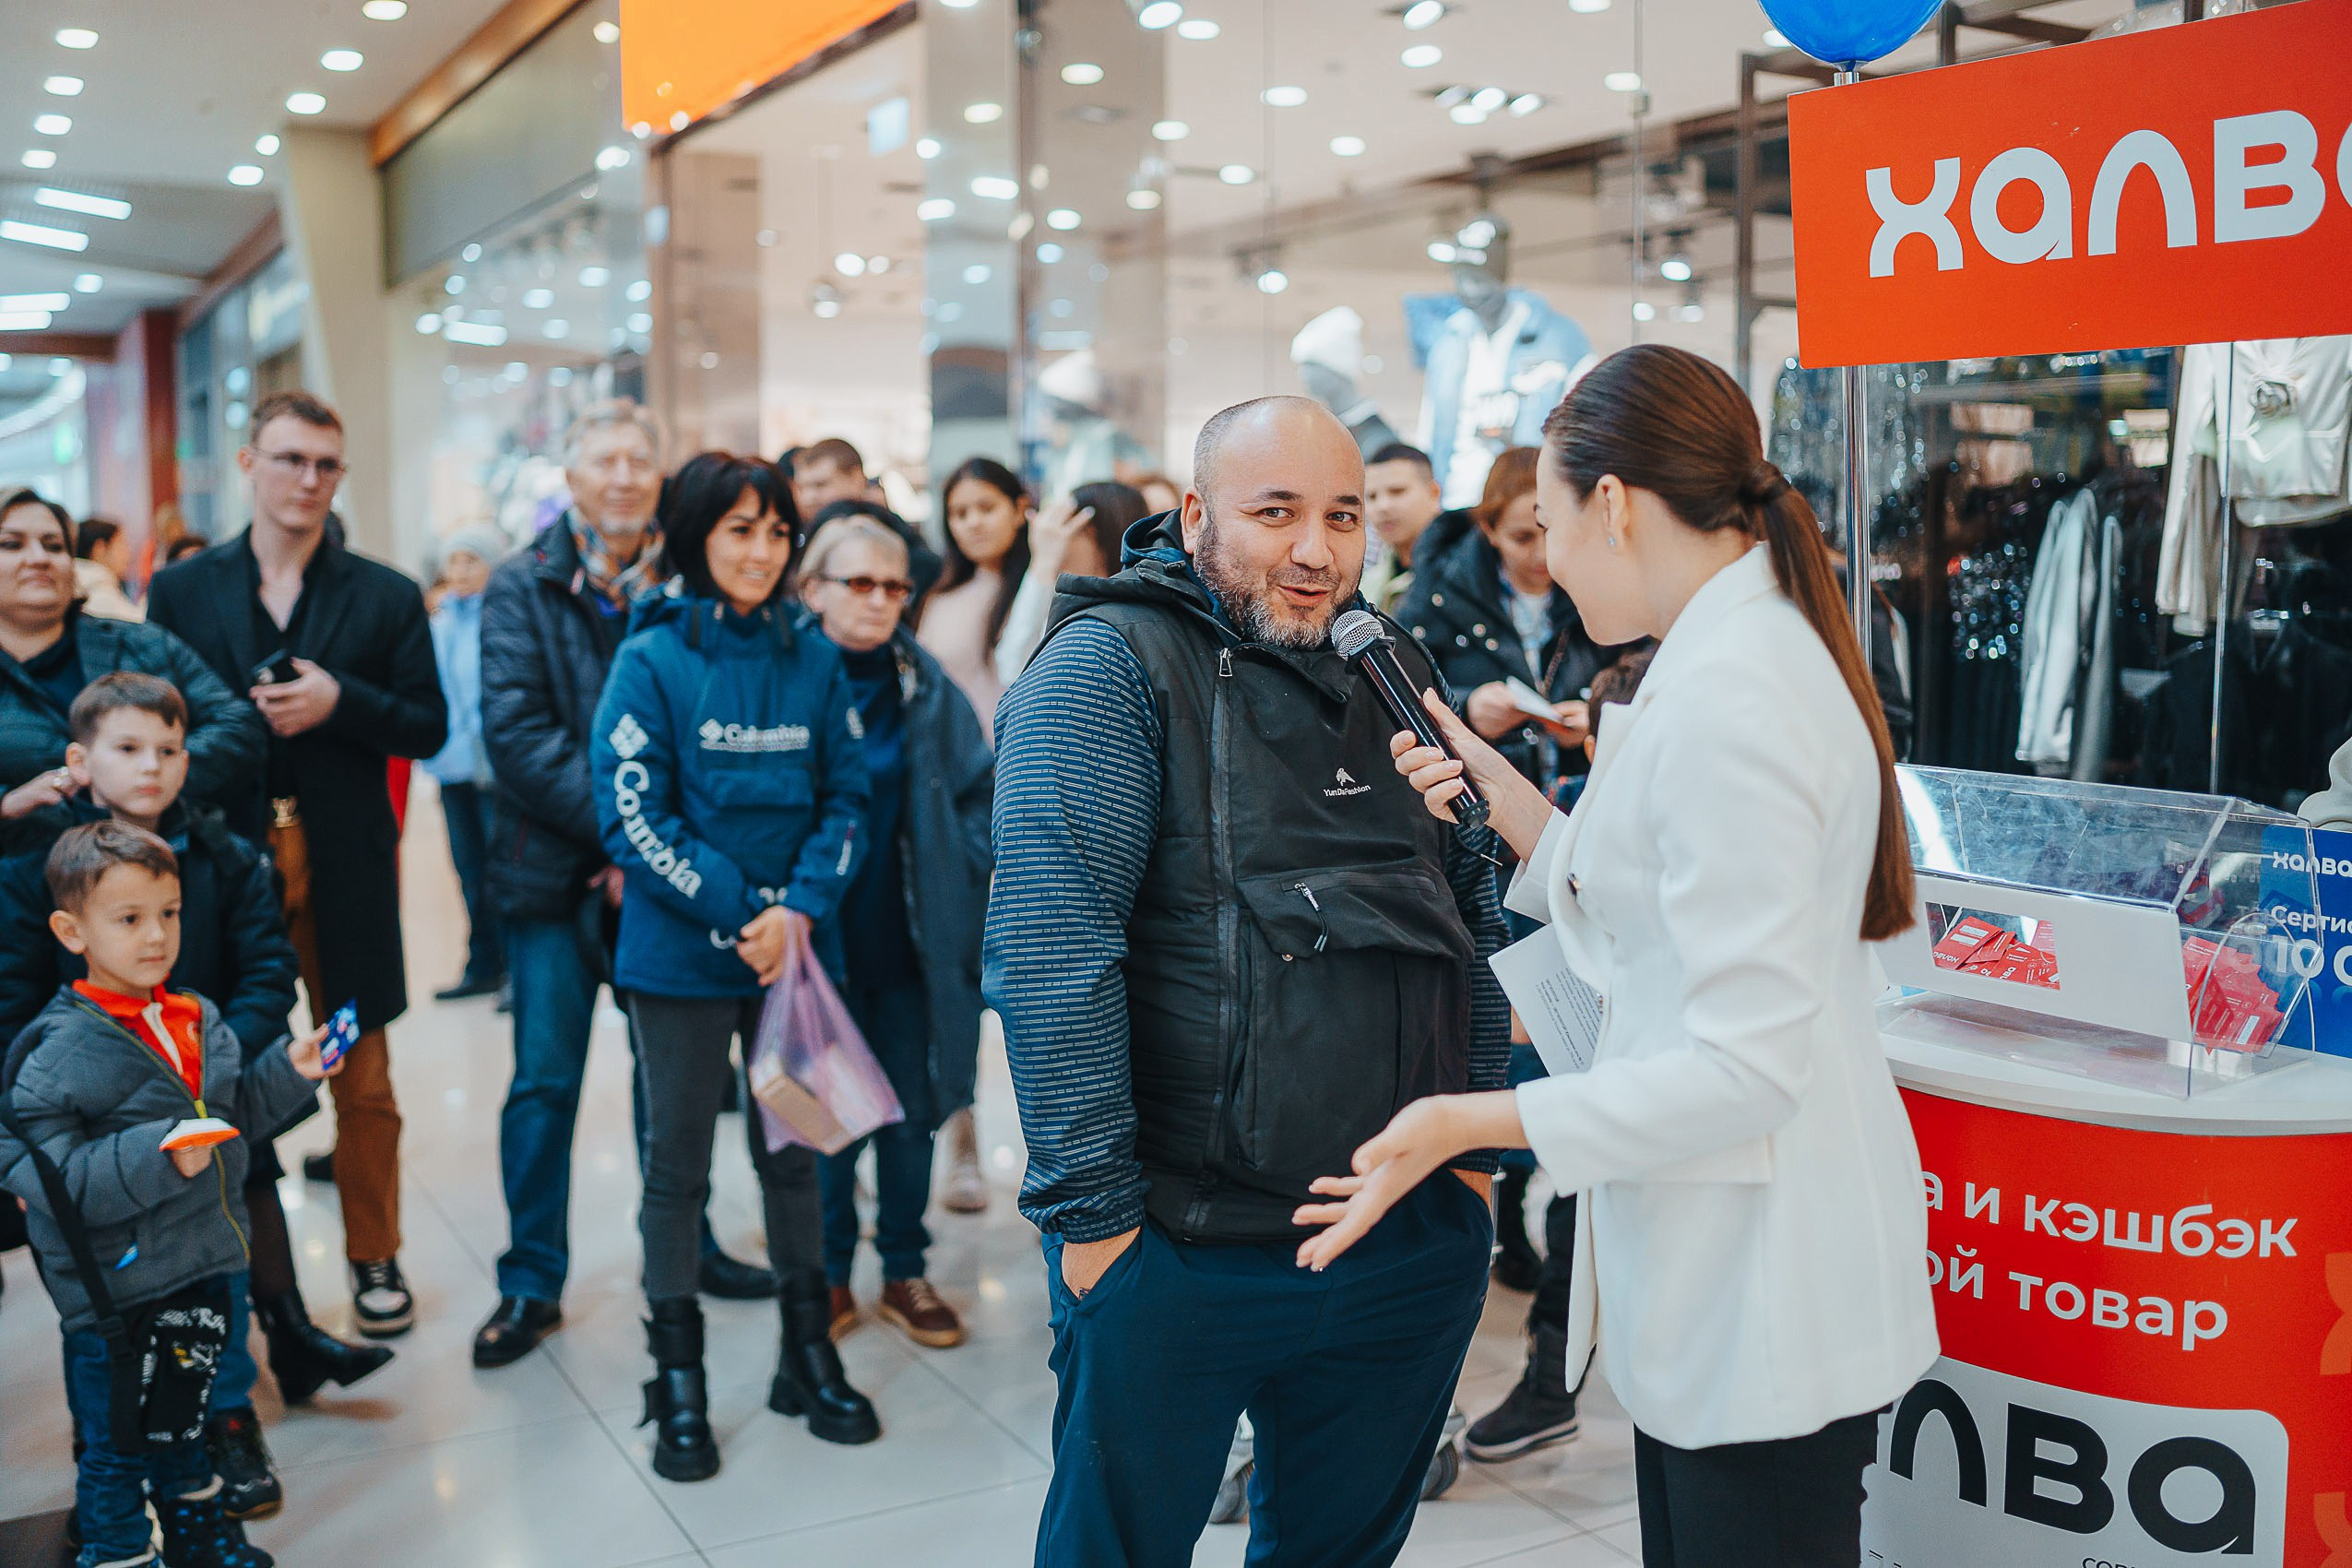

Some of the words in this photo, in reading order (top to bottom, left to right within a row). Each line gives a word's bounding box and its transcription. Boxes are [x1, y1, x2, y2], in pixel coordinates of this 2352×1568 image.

[1866, 110, 2352, 279] халв
[2271, 905, 2352, 934] Серти
[1965, 1182, 2000, 1224] и
[2024, 1195, 2298, 1258] кэшбэк
[2009, 1271, 2228, 1351] товар
[1861, 1378, 2256, 1555] лва
